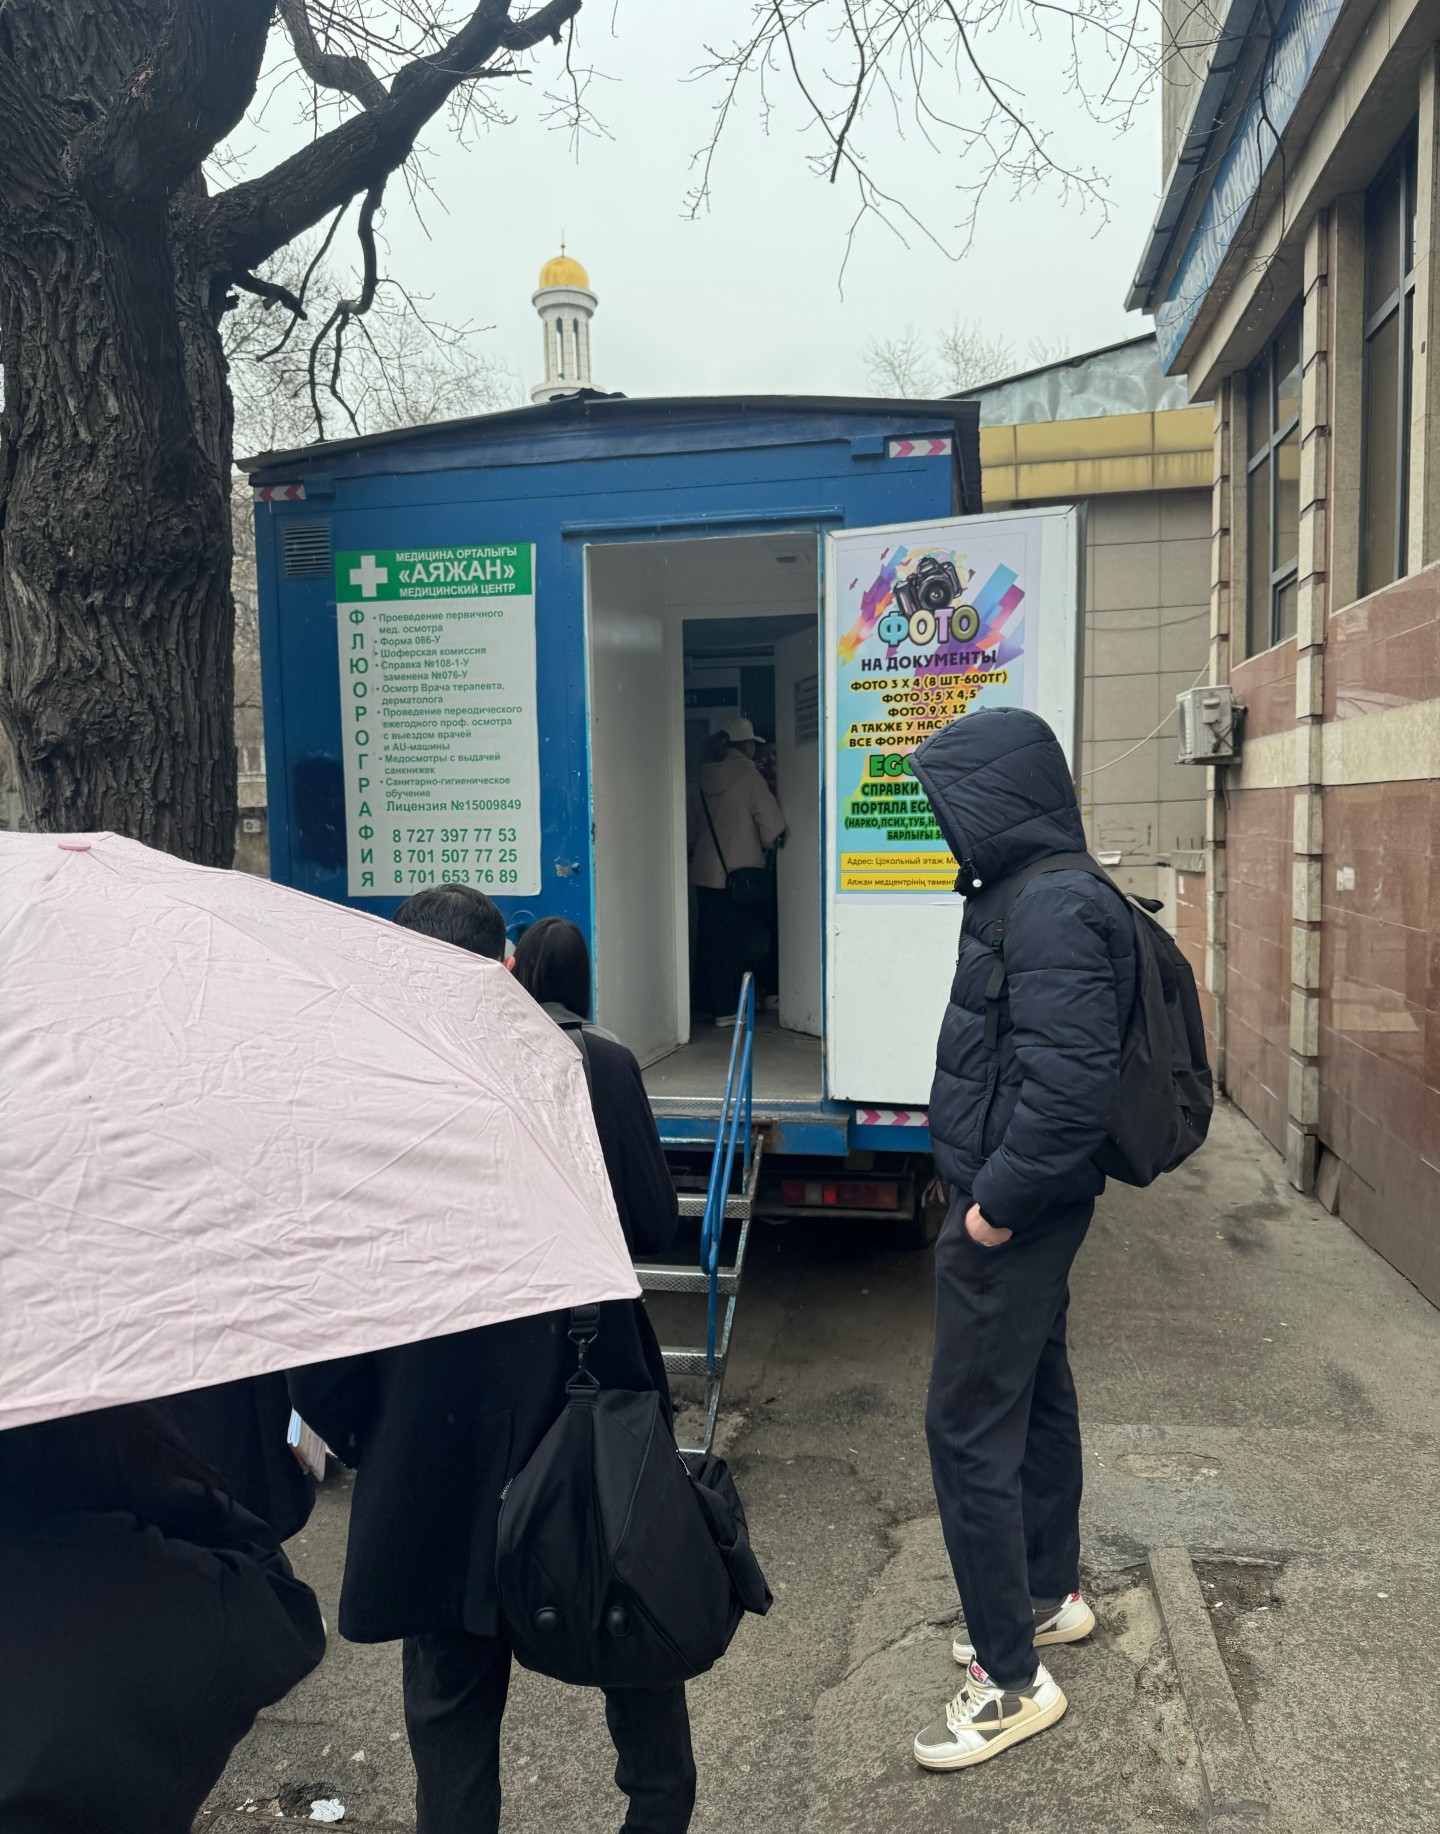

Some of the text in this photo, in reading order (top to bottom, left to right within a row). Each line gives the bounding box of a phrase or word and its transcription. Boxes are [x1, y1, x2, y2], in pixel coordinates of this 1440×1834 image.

[396, 550, 454, 562] МЕДИЦИНА
[399, 559, 515, 583] «АЯЖАН»
[399, 583, 515, 597] МЕДИЦИНСКИЙ ЦЕНТР
[446, 610, 503, 622] первичного
[403, 624, 442, 634] осмотра
[878, 605, 979, 647] ФОТО
[380, 635, 440, 646] Форма 086-У
[380, 647, 486, 659] Шоферская комиссия
[381, 658, 469, 670] Справка №108-1-У
[861, 650, 997, 672] НА ДОКУМЕНТЫ
[384, 670, 468, 681] заменена №076-У
[850, 680, 887, 691] ФОТО
[892, 678, 897, 688] 3
[913, 677, 920, 688] 4
[924, 675, 935, 688] (8
[940, 671, 1008, 686] ШТ-600ТГ)
[382, 682, 504, 694] Осмотр Врача терапевта,
[382, 696, 443, 706] дерматолога
[882, 692, 919, 703] ФОТО
[923, 691, 942, 703] 3,5
[957, 689, 976, 700] 4,5
[383, 705, 522, 718] Проведение переодического
[887, 706, 925, 717] ФОТО
[929, 705, 935, 715] 9
[952, 704, 966, 714] 12
[383, 718, 512, 728] ежегодного проф. осмотра
[850, 725, 857, 733] А
[861, 722, 901, 733] ТАКЖЕ
[904, 722, 913, 730] У
[917, 720, 942, 730] НАС
[392, 731, 434, 740] выездом
[438, 730, 471, 739] врачей
[349, 608, 375, 888] ФЛЮОРОГРАФИЯ
[849, 738, 871, 747] ВСЕ
[385, 754, 447, 763] Медосмотры
[458, 752, 500, 762] выдачей
[386, 776, 510, 787] Санитарно-гигиеническое
[386, 789, 430, 799] обучение
[861, 783, 919, 796] СПРАВКИ
[386, 799, 521, 812] Лицензия №15009849
[851, 802, 907, 814] ПОРТАЛА
[392, 828, 516, 843] 8 727 397 77 53
[393, 849, 517, 863] 8 701 507 77 25
[875, 855, 920, 866] Цокольный
[394, 869, 517, 883] 8 701 653 76 89
